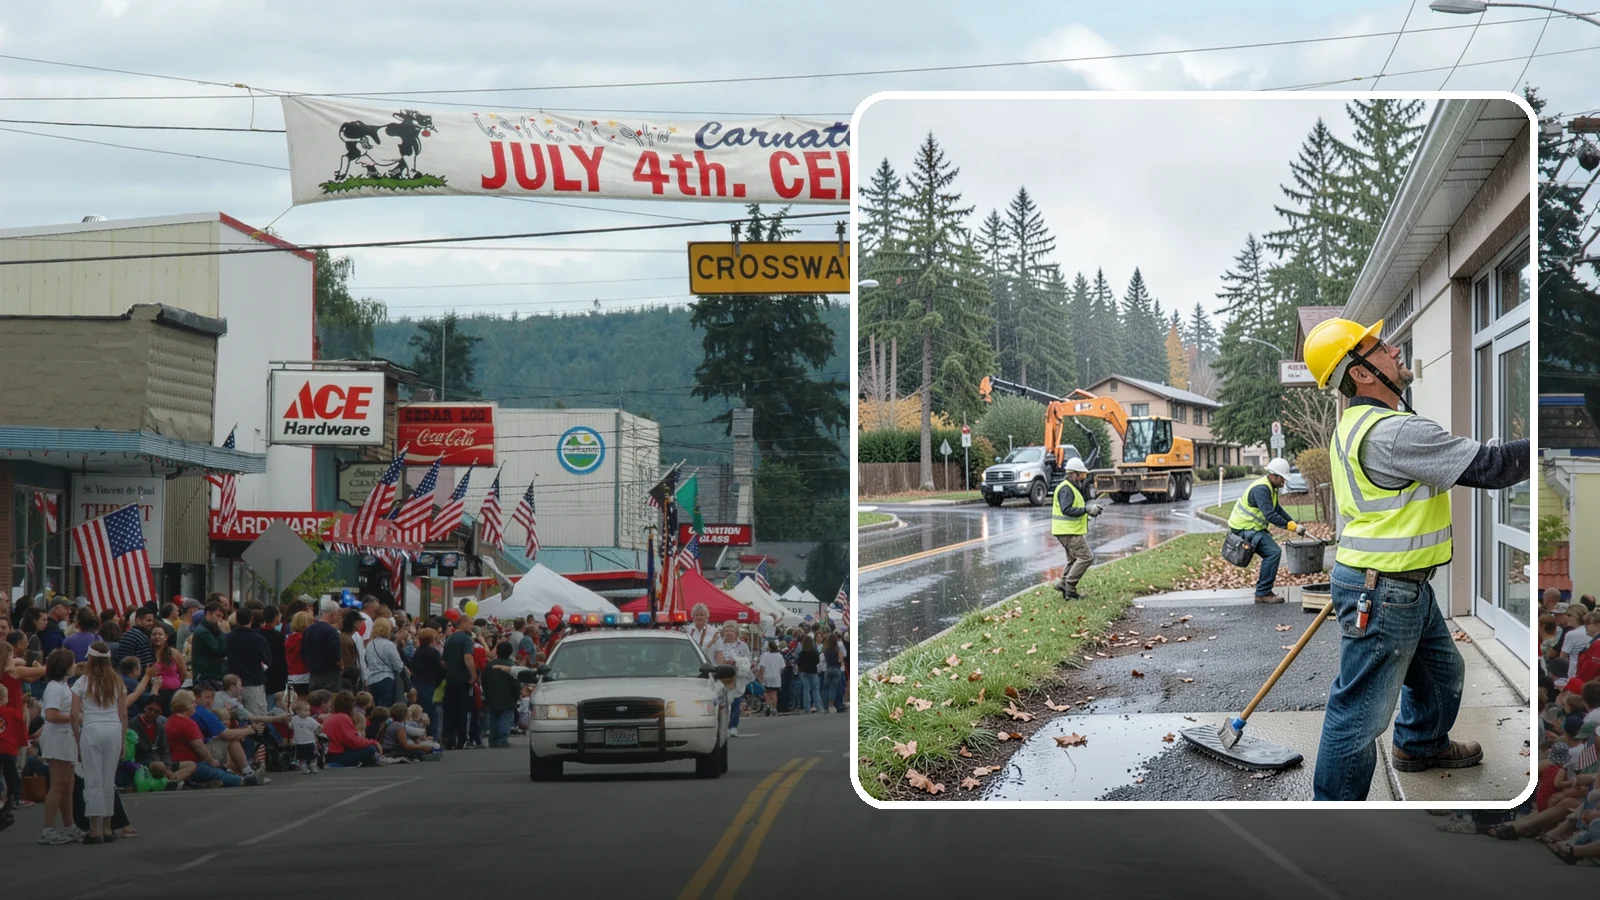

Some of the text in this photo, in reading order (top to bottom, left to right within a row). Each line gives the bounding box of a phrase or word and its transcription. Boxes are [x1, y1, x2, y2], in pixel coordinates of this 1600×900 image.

[481, 141, 605, 192] JULY
[632, 149, 746, 198] 4th.
[696, 254, 850, 280] CROSSWA
[283, 380, 374, 420] ACE
[405, 409, 485, 422] CEDAR LOG
[283, 421, 371, 436] Hardware
[416, 428, 477, 447] Coca-Cola
[353, 467, 385, 480] Simpl
[83, 484, 155, 496] St. Vincent de Paul
[688, 526, 741, 535] CRNATION
[699, 535, 730, 543] GLASS
